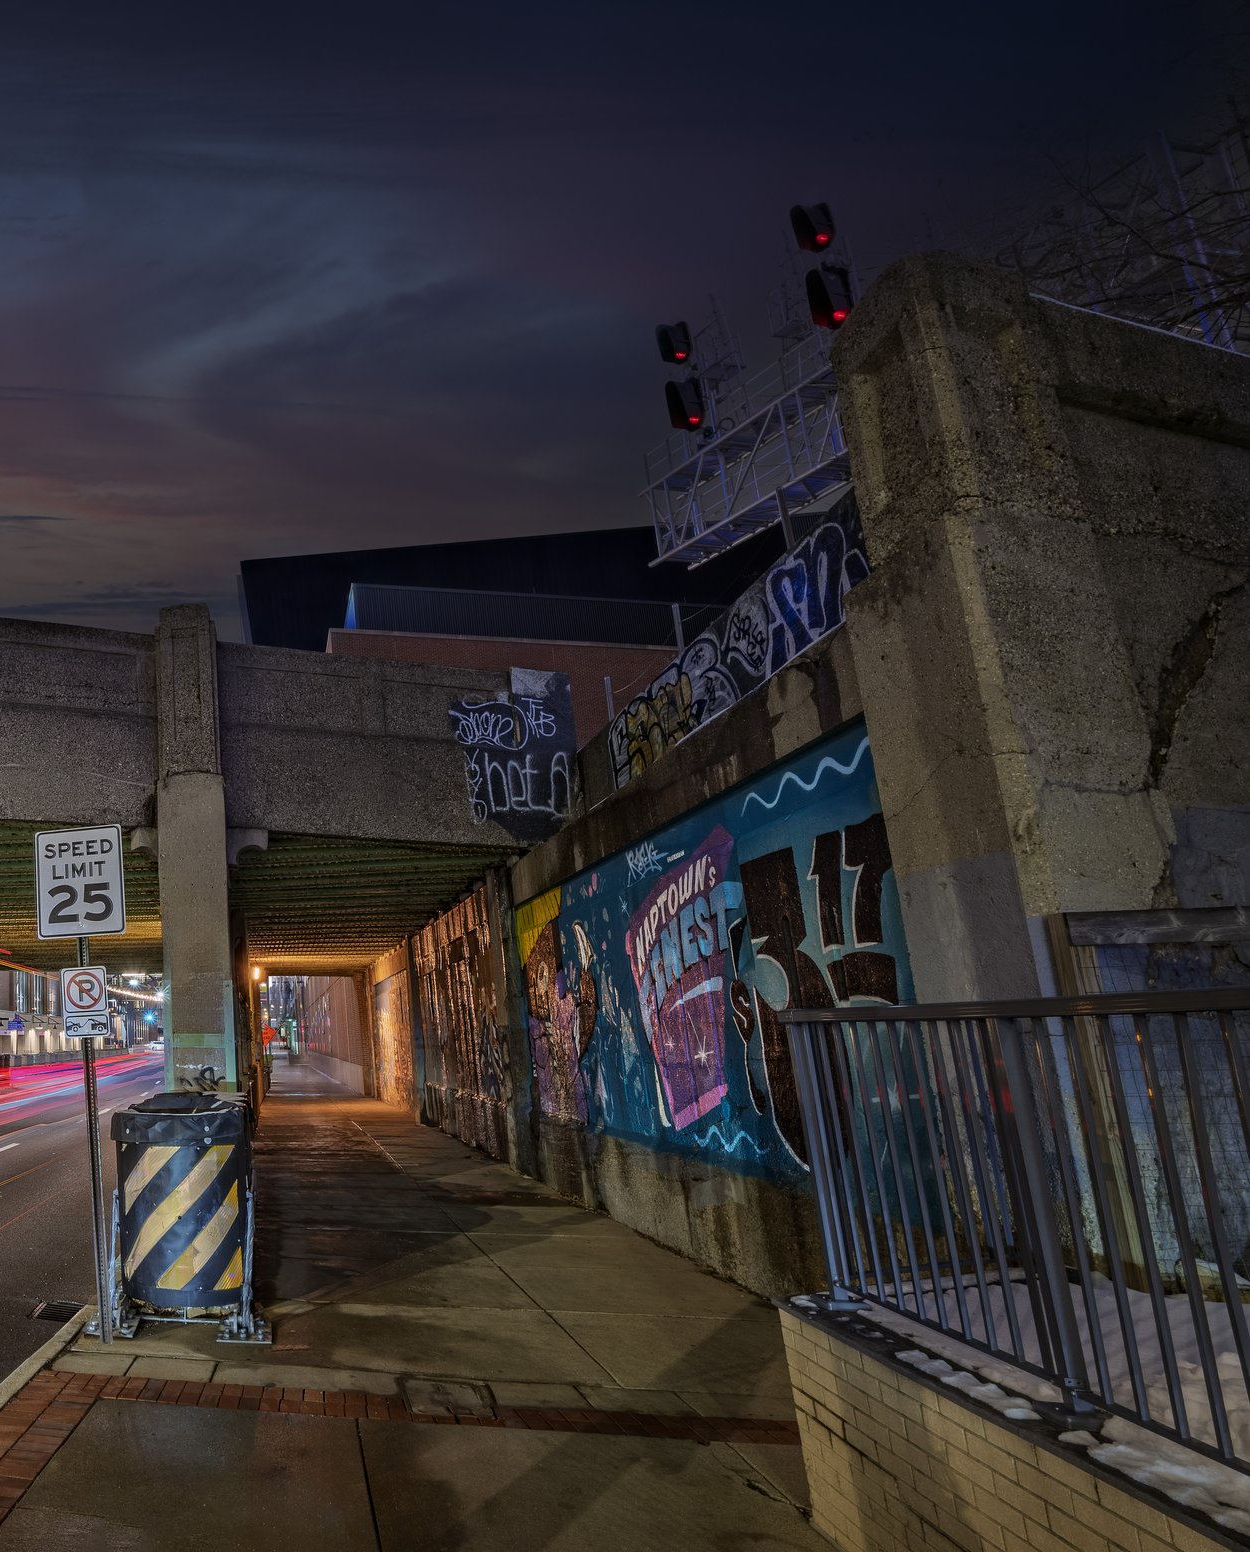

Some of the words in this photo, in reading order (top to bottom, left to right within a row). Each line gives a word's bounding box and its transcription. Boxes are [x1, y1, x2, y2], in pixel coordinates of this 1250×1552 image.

[44, 838, 114, 860] SPEED
[52, 861, 106, 881] LIMIT
[47, 882, 114, 924] 25
